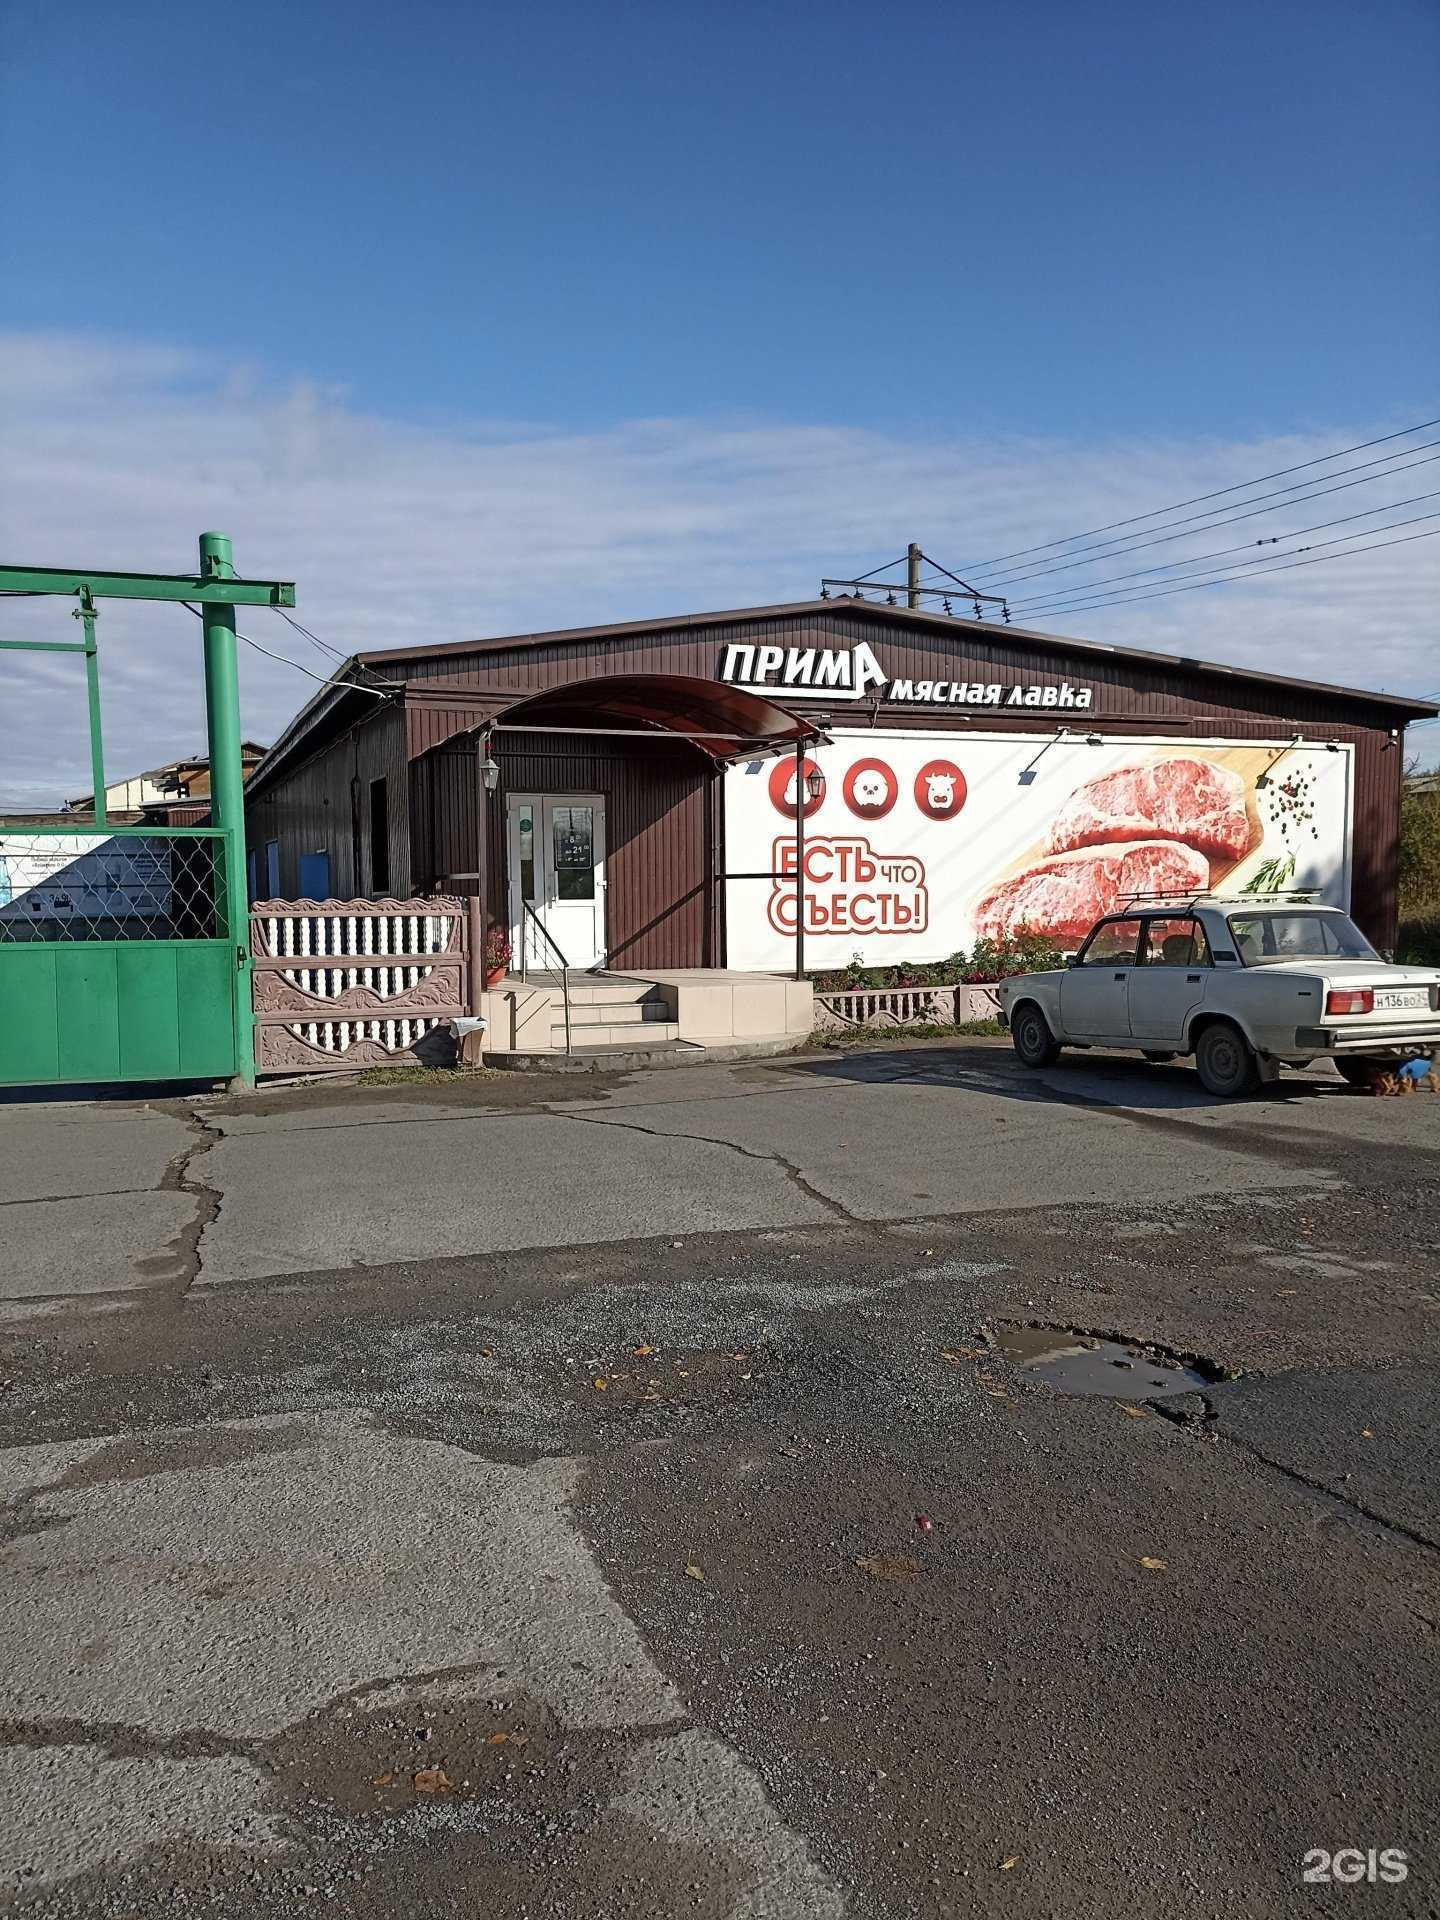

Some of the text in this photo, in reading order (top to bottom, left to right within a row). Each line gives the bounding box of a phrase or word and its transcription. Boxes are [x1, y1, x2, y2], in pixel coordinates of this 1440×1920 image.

[722, 642, 888, 698] ПРИМА
[889, 679, 1093, 708] мясная лавка
[781, 846, 876, 883] ЕСТЬ
[776, 893, 920, 926] СЪЕСТЬ!
